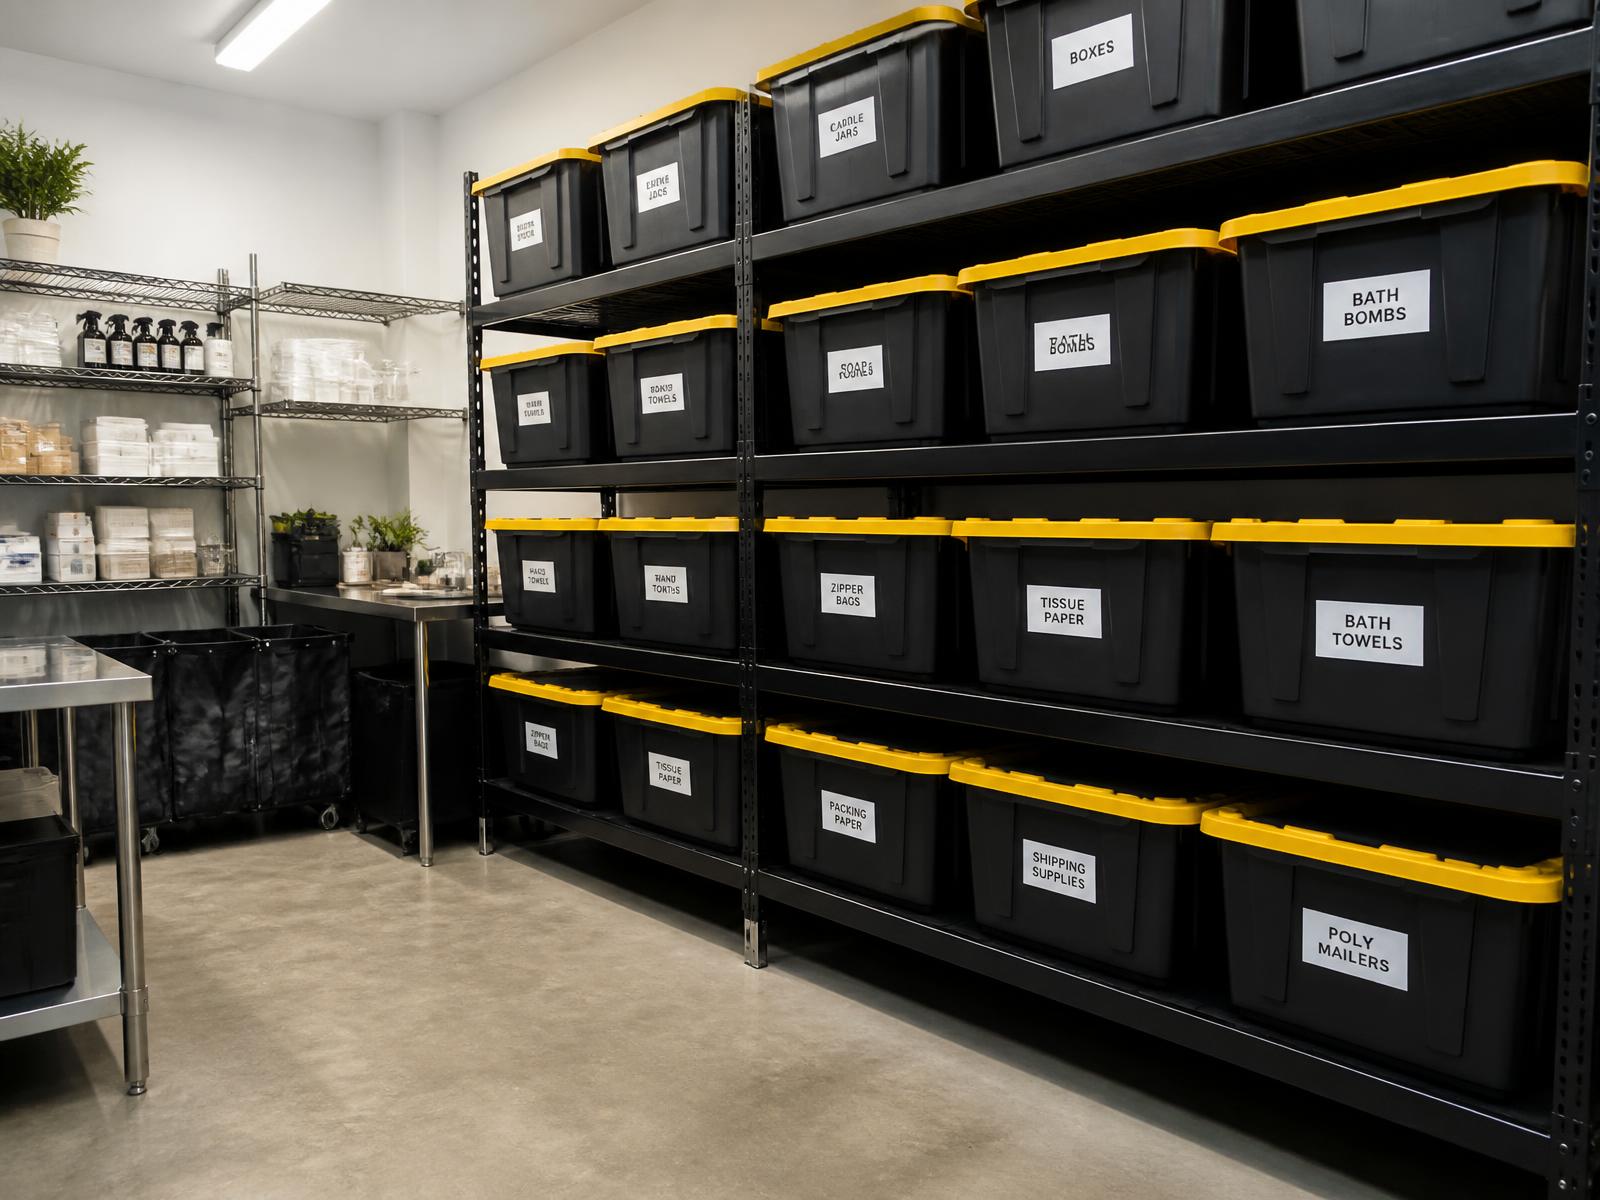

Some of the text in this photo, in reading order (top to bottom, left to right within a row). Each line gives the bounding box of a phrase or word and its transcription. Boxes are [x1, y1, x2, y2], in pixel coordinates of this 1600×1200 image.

[1069, 40, 1115, 65] BOXES
[835, 126, 859, 142] JARS
[1352, 287, 1399, 307] BATH
[1343, 306, 1406, 326] BOMBS
[830, 583, 864, 595] ZIPPER
[836, 596, 861, 607] BAGS
[1040, 597, 1085, 611] TISSUE
[1043, 612, 1085, 626] PAPER
[1344, 614, 1391, 630] BATH
[1332, 632, 1403, 650] TOWELS
[655, 761, 682, 776] TISSUE
[829, 801, 867, 820] PACKING
[834, 815, 862, 831] PAPER
[1032, 851, 1086, 875] SHIPPING
[1032, 866, 1085, 890] SUPPLIES
[1328, 926, 1374, 950] POLY
[1318, 942, 1390, 973] MAILERS
